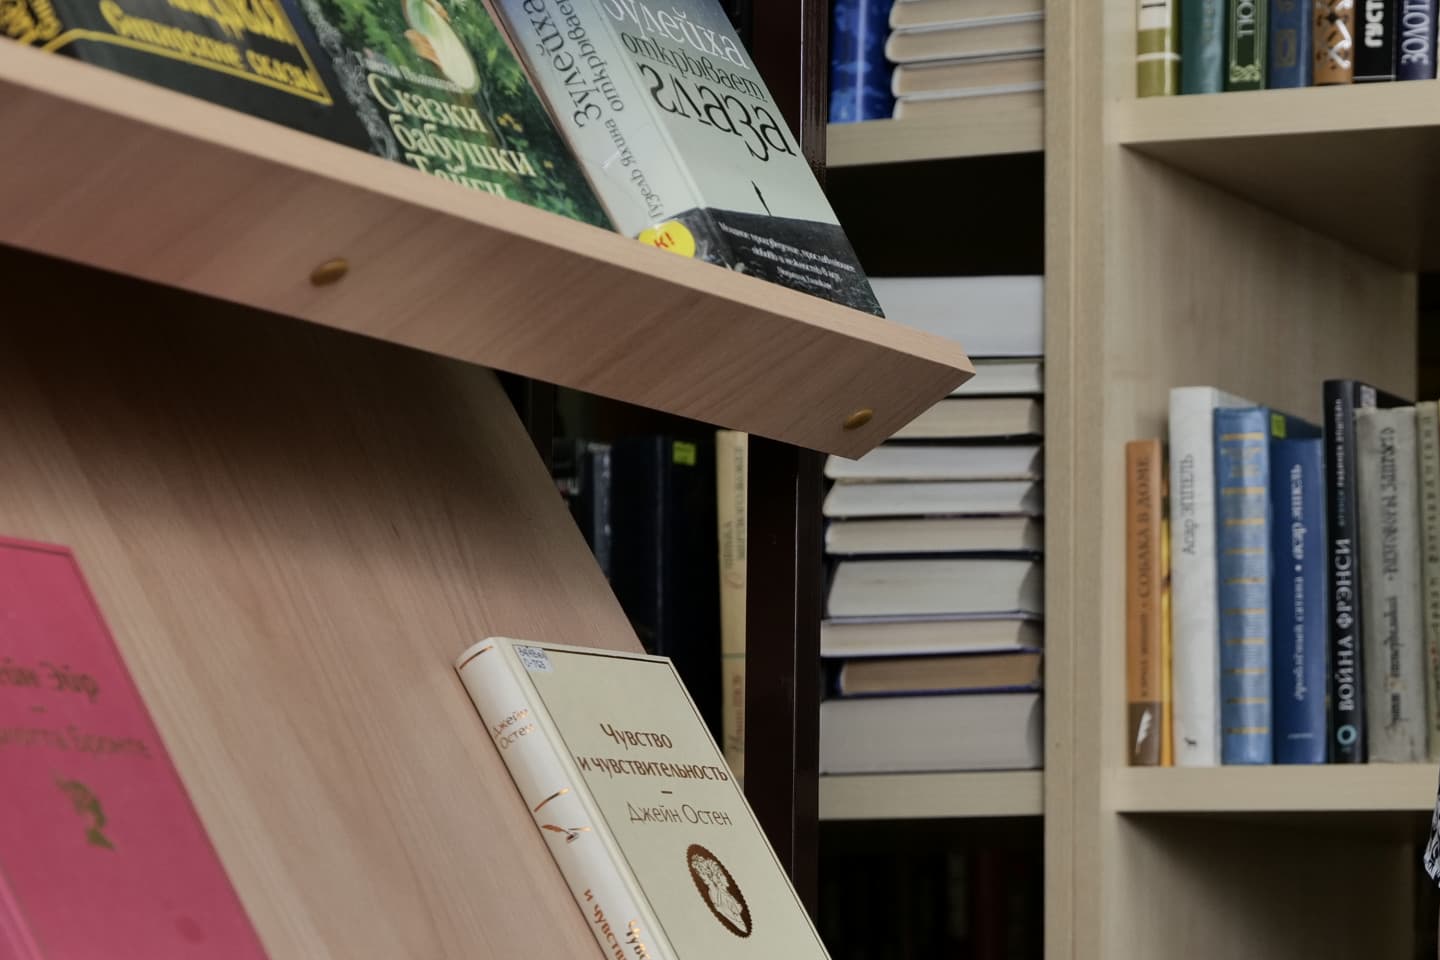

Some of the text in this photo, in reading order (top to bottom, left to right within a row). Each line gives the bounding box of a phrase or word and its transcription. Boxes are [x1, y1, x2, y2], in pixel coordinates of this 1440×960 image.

[557, 0, 624, 112] открывае
[1401, 0, 1430, 65] ЗОЛОТ
[621, 32, 769, 103] открывает
[368, 73, 488, 133] Сказки
[637, 63, 797, 162] глаза
[389, 114, 536, 177] бабушки
[605, 118, 665, 219] Гузель Яхина
[1135, 455, 1152, 508] ДОМЕ
[1179, 454, 1199, 556] Асар ЭППЕЛЬ
[1136, 512, 1150, 523] В
[1291, 523, 1307, 560] асар
[1136, 527, 1151, 599] СОБАКА
[1334, 538, 1353, 629] ФРЭНСИ
[1336, 635, 1355, 711] ВОЙНА
[492, 708, 530, 738] Джейн
[498, 723, 536, 750] Остен
[601, 723, 673, 751] Чувство
[577, 756, 729, 782] и чувствительность
[628, 801, 734, 828] Джейн Остен
[583, 889, 594, 903] и
